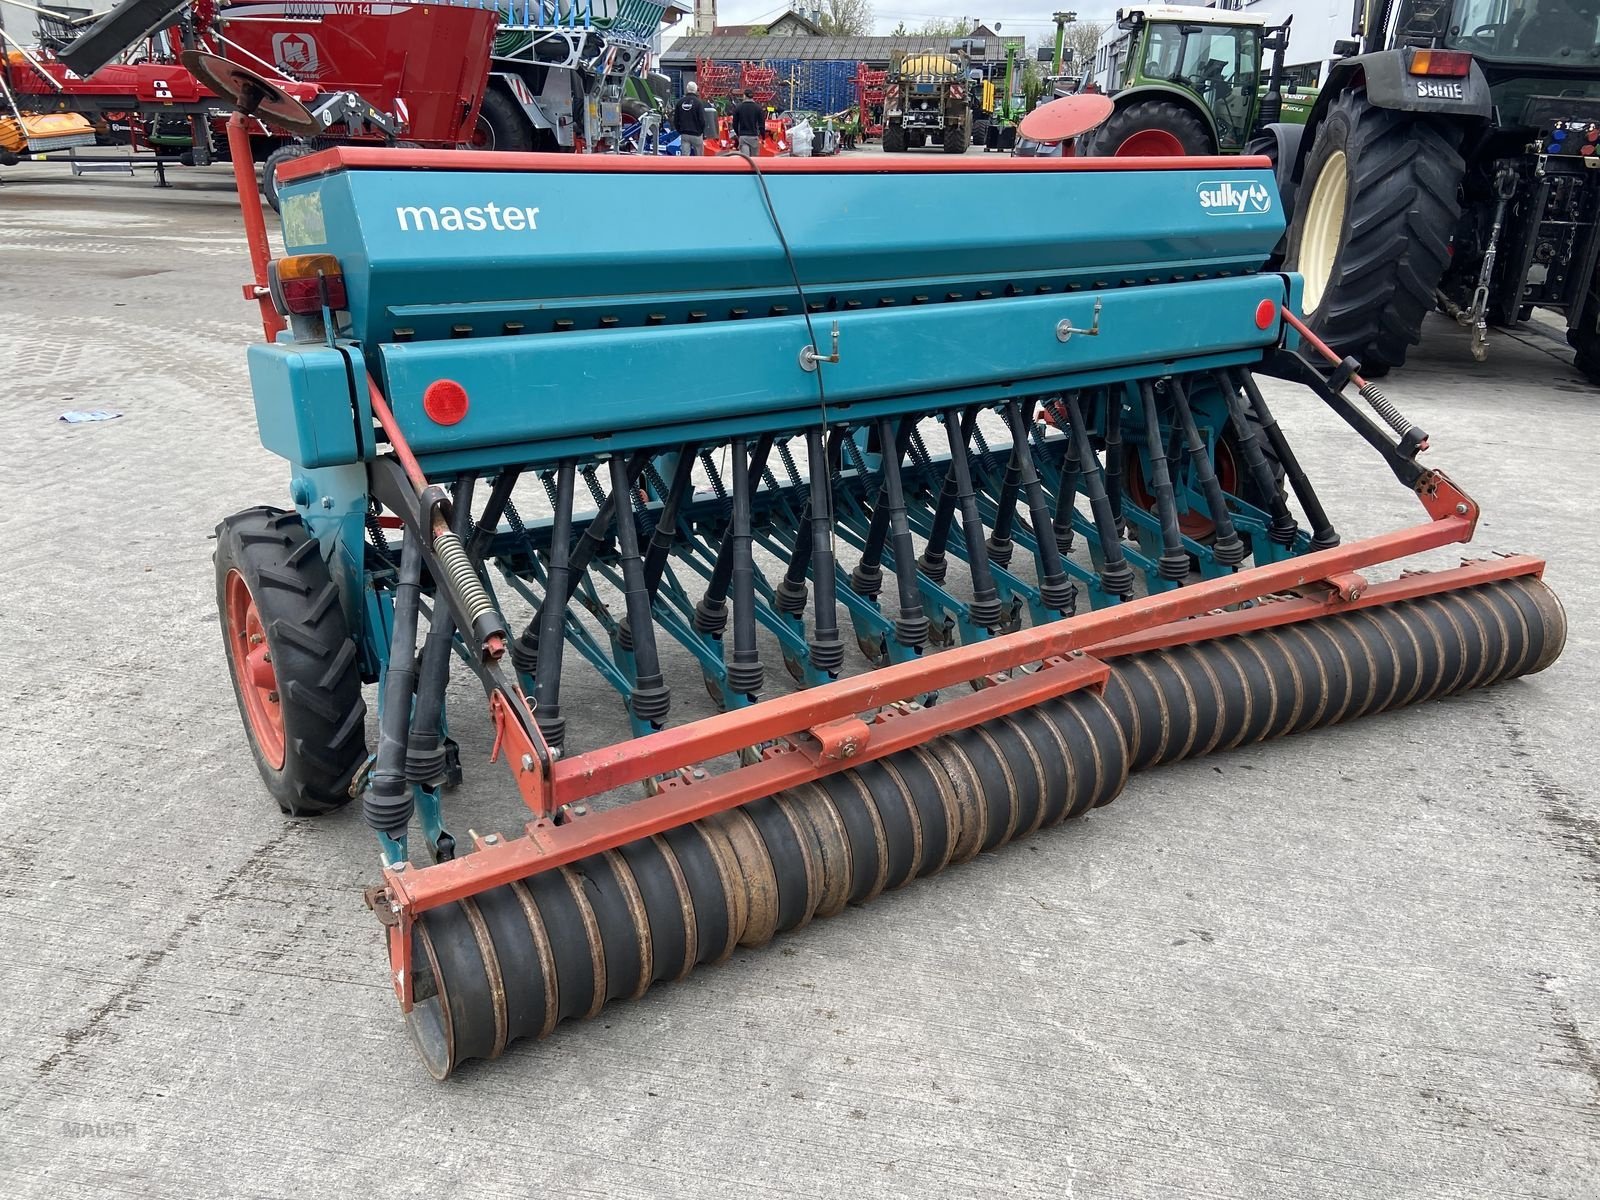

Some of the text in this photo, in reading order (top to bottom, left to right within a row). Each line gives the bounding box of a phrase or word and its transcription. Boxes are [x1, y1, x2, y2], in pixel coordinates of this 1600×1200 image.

[336, 3, 371, 15] VM 14
[1199, 183, 1248, 212] sulky
[396, 201, 540, 231] master
